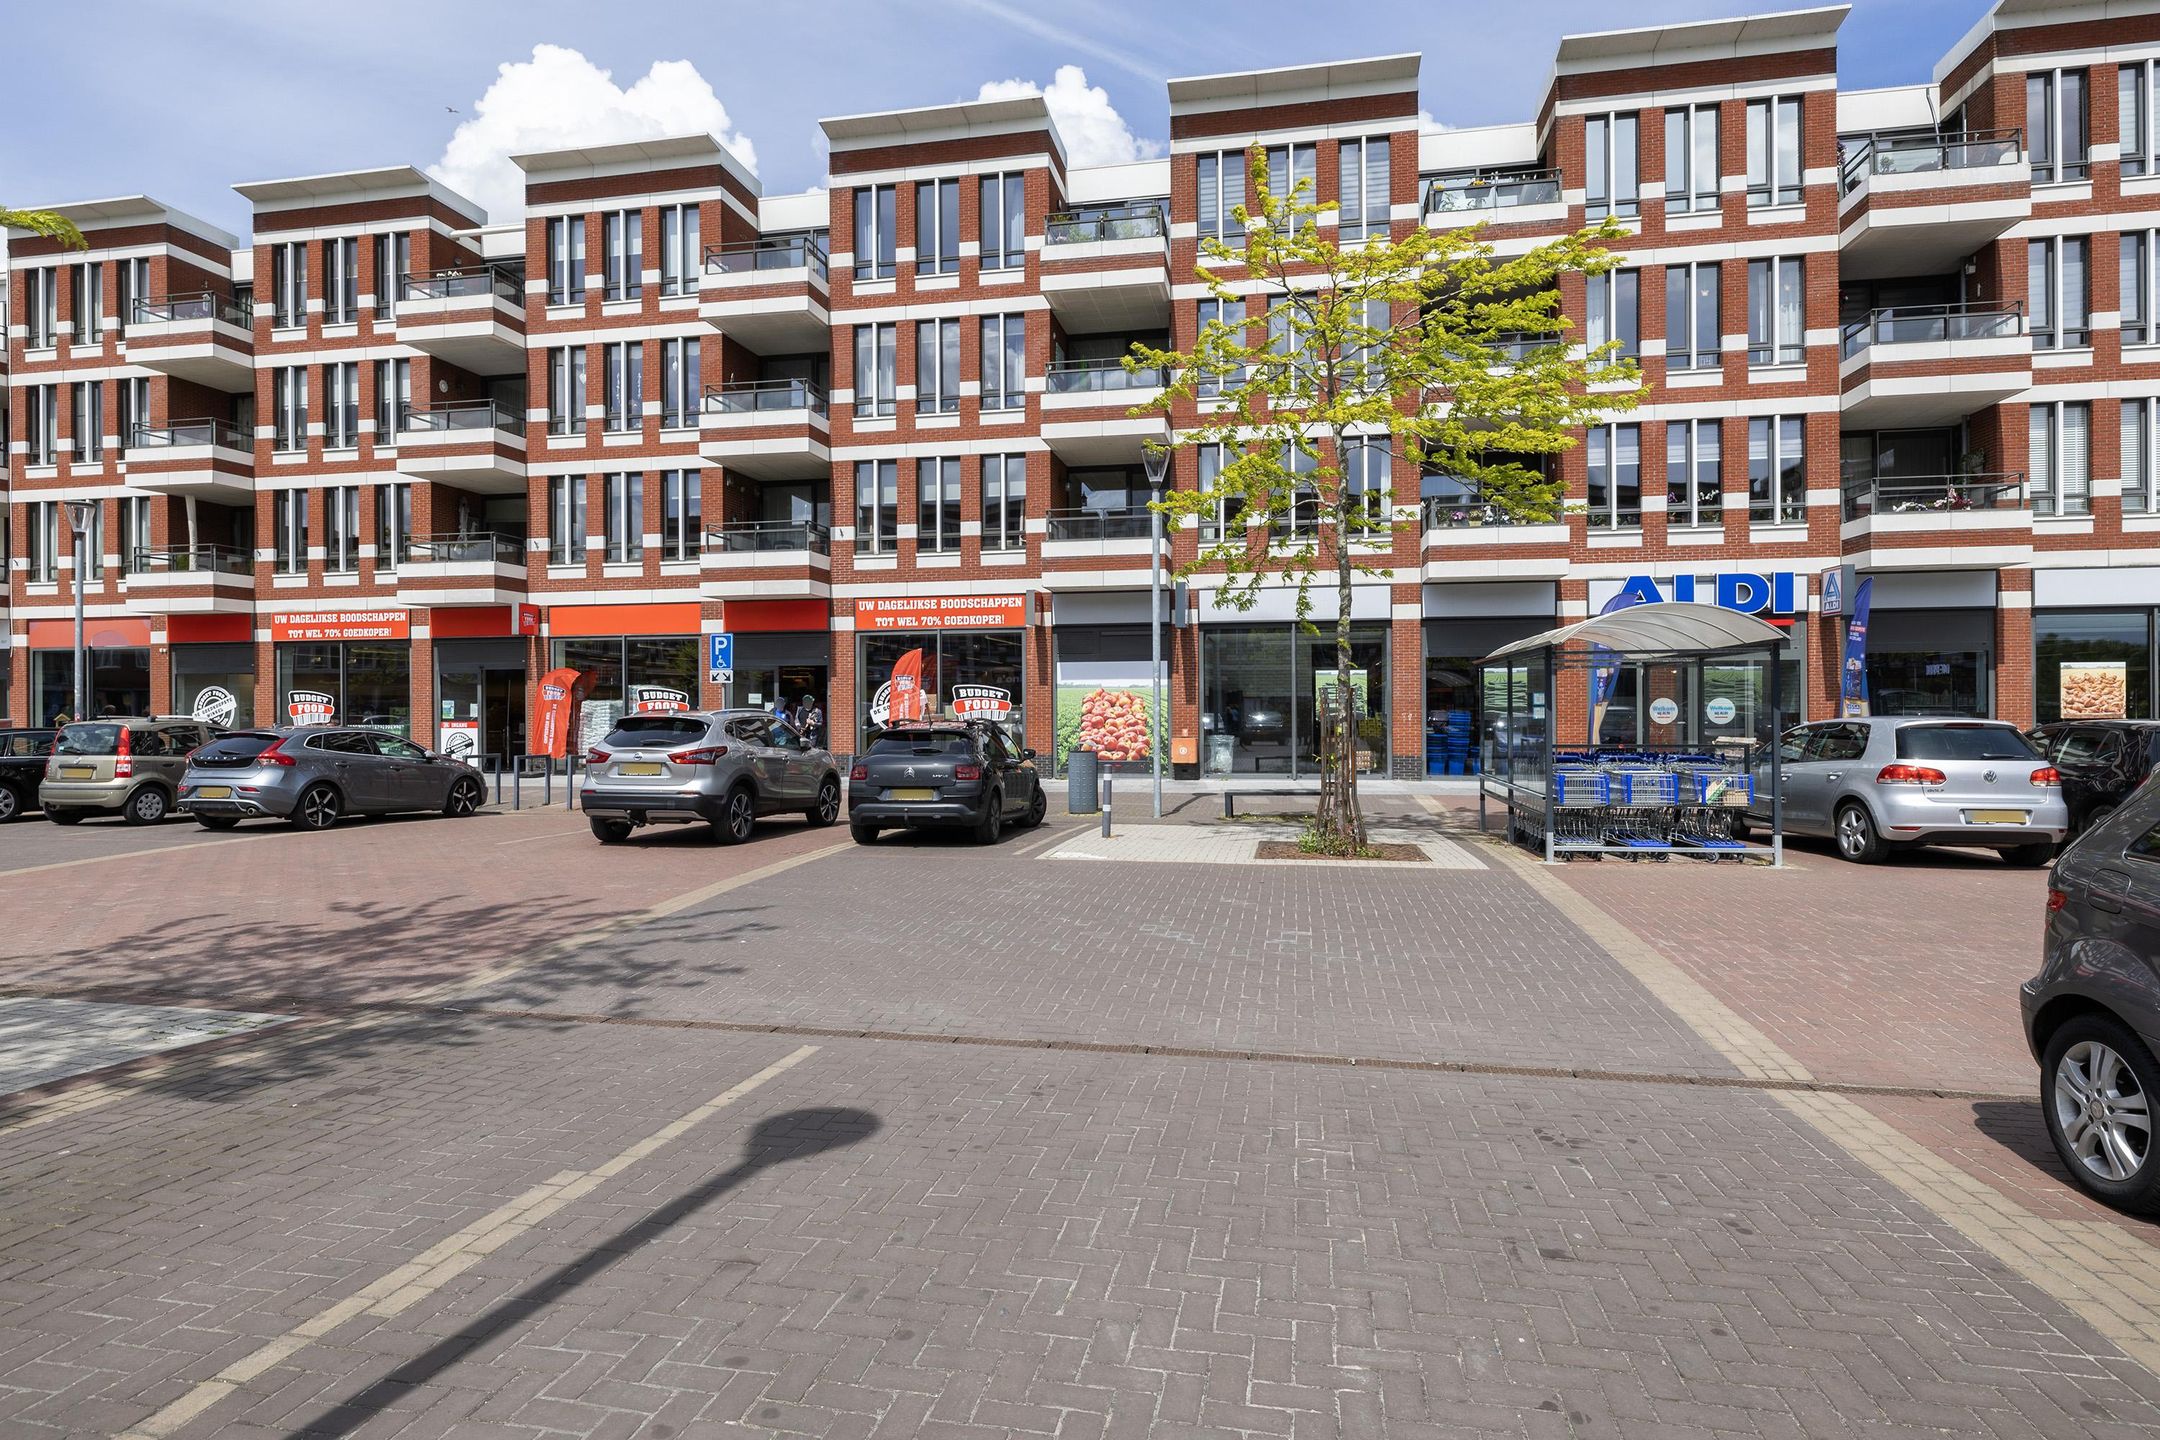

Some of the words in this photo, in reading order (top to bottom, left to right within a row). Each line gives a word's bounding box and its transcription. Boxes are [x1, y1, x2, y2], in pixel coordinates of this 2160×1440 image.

[858, 601, 875, 611] UW
[877, 599, 937, 610] DAGELIJKSE
[940, 597, 1023, 609] BOODSCHAPPEN
[1825, 601, 1839, 610] ALDI
[274, 615, 288, 624] UW
[289, 613, 338, 624] DAGELIJKSE
[340, 612, 406, 623] BOODSCHAPPEN
[875, 617, 895, 627] TOT
[897, 617, 919, 626] WEL
[921, 616, 942, 626] 70%
[944, 615, 1005, 625] GOEDKOPER!
[288, 629, 304, 638] TOT
[305, 629, 323, 638] WEL
[324, 628, 342, 637] 70%
[343, 627, 392, 637] GOEDKOPER!
[715, 637, 728, 655] P
[293, 694, 329, 703] BUDGET
[642, 691, 683, 701] BUDGET
[958, 688, 1004, 699] BUDGET
[297, 703, 325, 714] FOOD
[647, 701, 679, 710] FOOD
[963, 699, 1000, 711] FOOD
